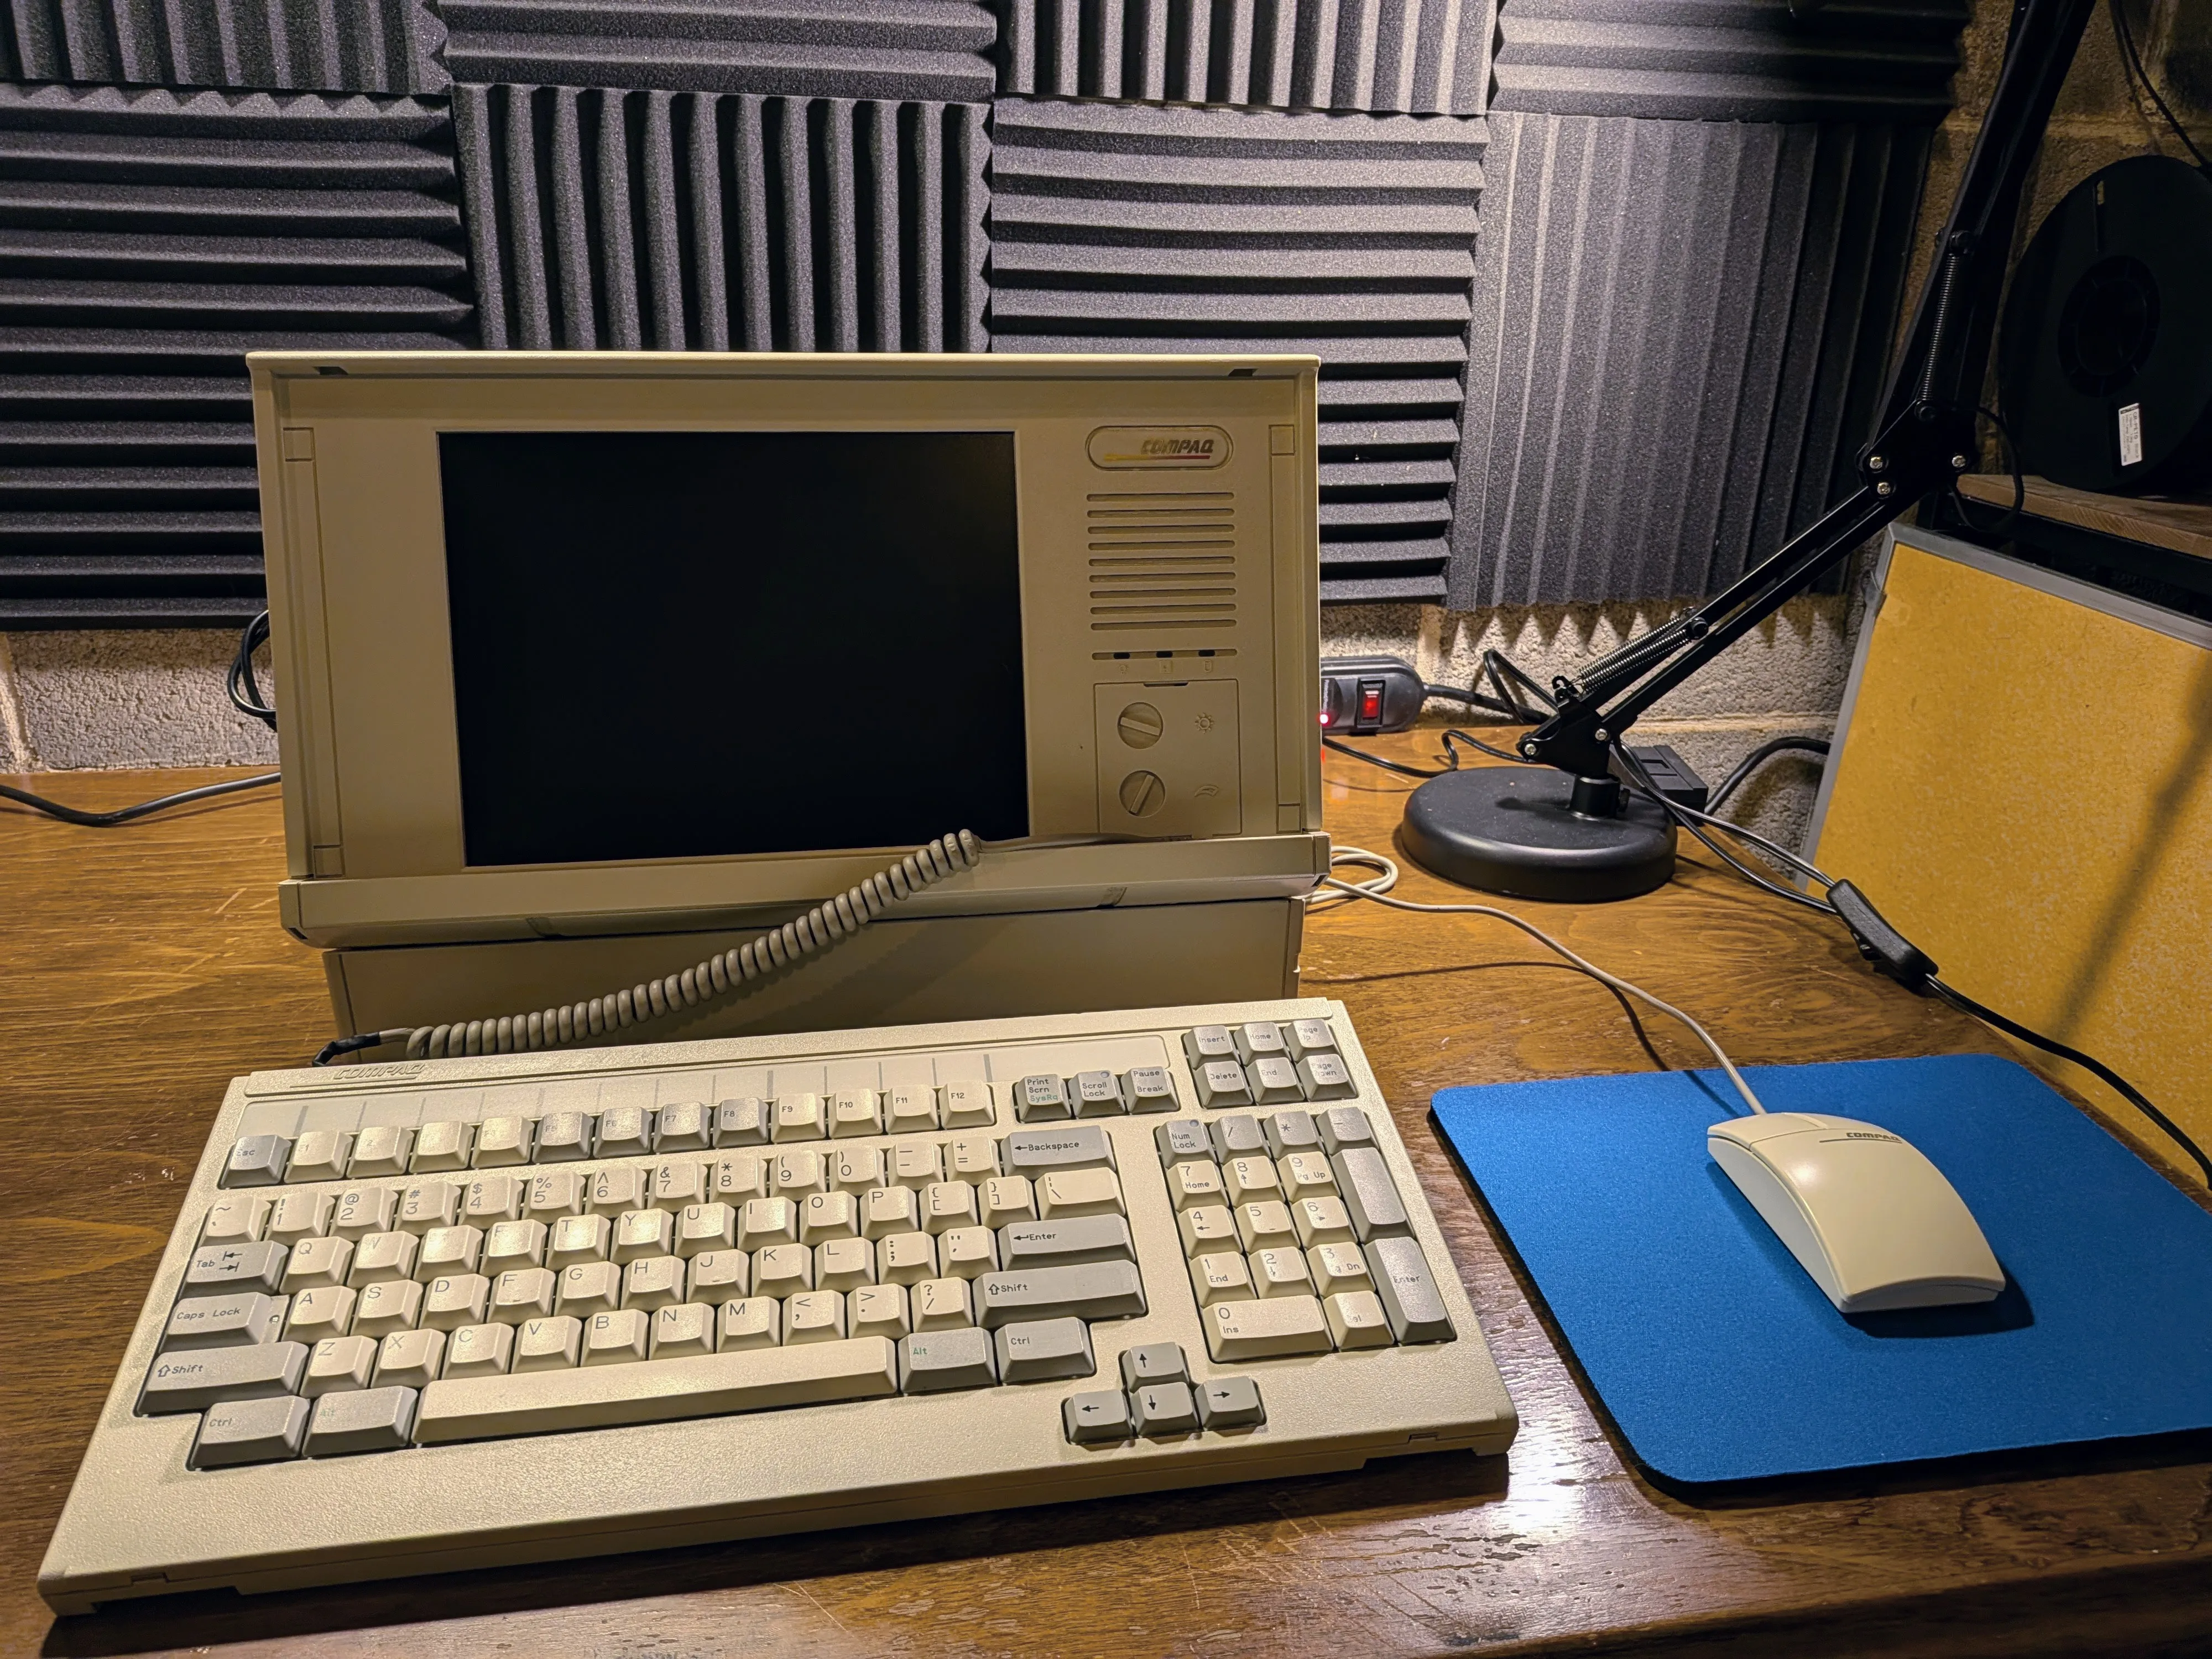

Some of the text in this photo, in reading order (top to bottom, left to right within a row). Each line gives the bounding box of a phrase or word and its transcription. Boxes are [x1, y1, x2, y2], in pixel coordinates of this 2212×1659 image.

[1141, 439, 1214, 454] COMPAQ
[333, 1063, 424, 1079] COMPAQ
[1030, 1094, 1058, 1103] SysRq
[1846, 1132, 1901, 1141] COMPAQ
[1028, 1141, 1079, 1152] Backspace
[1173, 1141, 1196, 1149] Lock
[1237, 1162, 1248, 1172] 8
[1291, 1157, 1303, 1167] 9
[660, 1166, 671, 1178] &
[781, 1170, 792, 1182] 9
[1181, 1166, 1191, 1176] 7
[1313, 1171, 1326, 1179] Up
[536, 1176, 552, 1189] %
[659, 1180, 671, 1192] 7
[721, 1175, 732, 1187] 8
[1185, 1181, 1210, 1189] Home
[472, 1183, 483, 1194] $
[597, 1186, 608, 1198] 6
[345, 1193, 359, 1206] @
[470, 1197, 482, 1209] 4
[534, 1191, 546, 1203] 5
[811, 1196, 823, 1208] O
[872, 1192, 884, 1203] P
[405, 1202, 419, 1214] 3
[1250, 1206, 1261, 1217] 5
[1307, 1202, 1319, 1213] 6
[277, 1213, 283, 1225] 1
[340, 1208, 354, 1220] 2
[687, 1208, 700, 1220] U
[1193, 1211, 1203, 1222] 4
[561, 1219, 573, 1232] T
[625, 1214, 637, 1227] Y
[1030, 1233, 1056, 1241] Enter
[298, 1242, 312, 1255] Q
[827, 1243, 840, 1255] L
[1323, 1248, 1335, 1259] 3
[700, 1255, 713, 1267] J
[764, 1249, 777, 1261] K
[1264, 1253, 1277, 1264] 2
[196, 1260, 215, 1268] Tab
[634, 1261, 649, 1274] H
[1204, 1258, 1211, 1269] 1
[1347, 1262, 1360, 1271] Dn
[569, 1268, 583, 1280] G
[1209, 1274, 1228, 1283] End
[1392, 1275, 1421, 1284] Enter
[435, 1280, 450, 1292] D
[502, 1274, 518, 1287] F
[367, 1286, 382, 1299] S
[1001, 1283, 1028, 1293] Shift
[299, 1292, 313, 1305] A
[176, 1307, 241, 1321] Caps Lock
[729, 1302, 745, 1316] M
[1218, 1307, 1230, 1319] 0
[662, 1309, 677, 1322] N
[529, 1322, 542, 1335] V
[595, 1316, 609, 1329] B
[458, 1329, 473, 1342] C
[1222, 1326, 1239, 1334] Ins
[388, 1335, 405, 1349] X
[1010, 1336, 1030, 1345] Ctrl
[318, 1342, 336, 1356] Z
[913, 1347, 927, 1355] Alt
[172, 1364, 204, 1375] Shift
[209, 1417, 233, 1427] Ctrl
